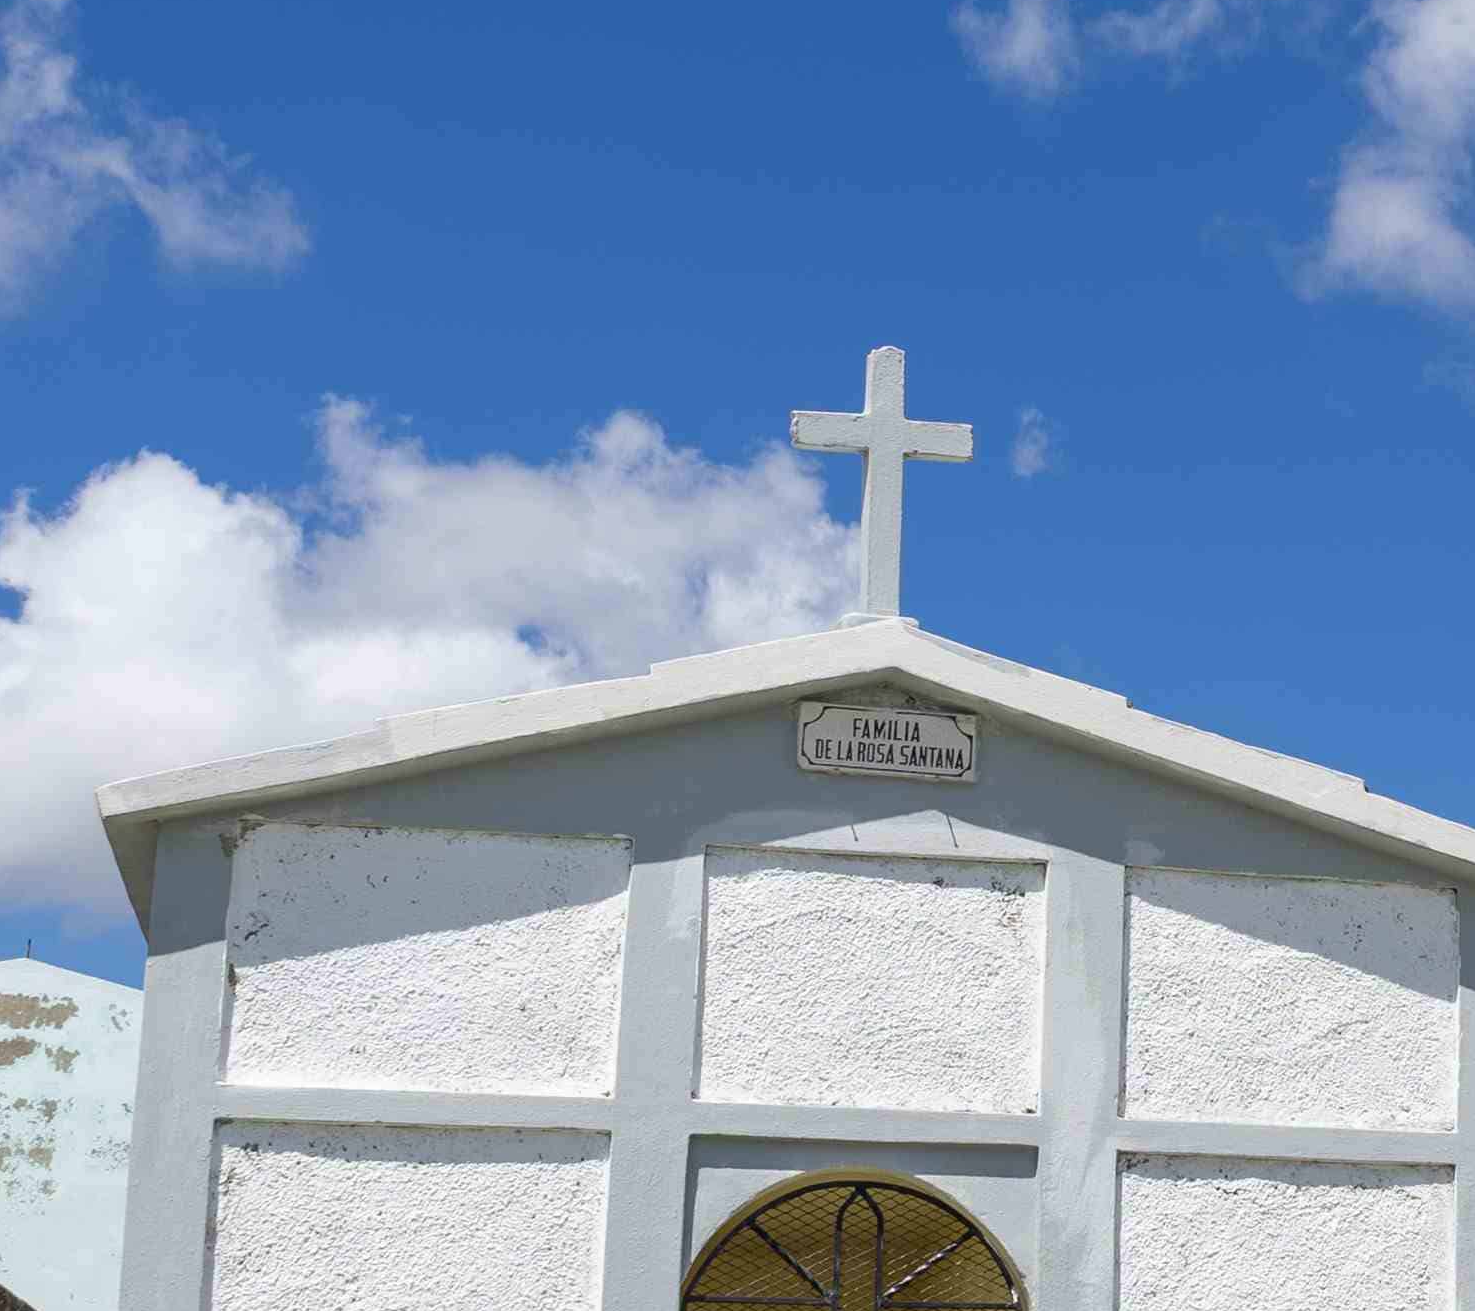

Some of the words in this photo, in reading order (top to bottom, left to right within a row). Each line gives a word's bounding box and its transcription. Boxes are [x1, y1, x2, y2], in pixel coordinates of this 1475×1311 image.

[853, 718, 920, 743] FAMILIA
[815, 739, 832, 759] DE
[837, 741, 853, 762] LA
[857, 742, 894, 765] ROSA
[899, 745, 964, 770] SANTANA
